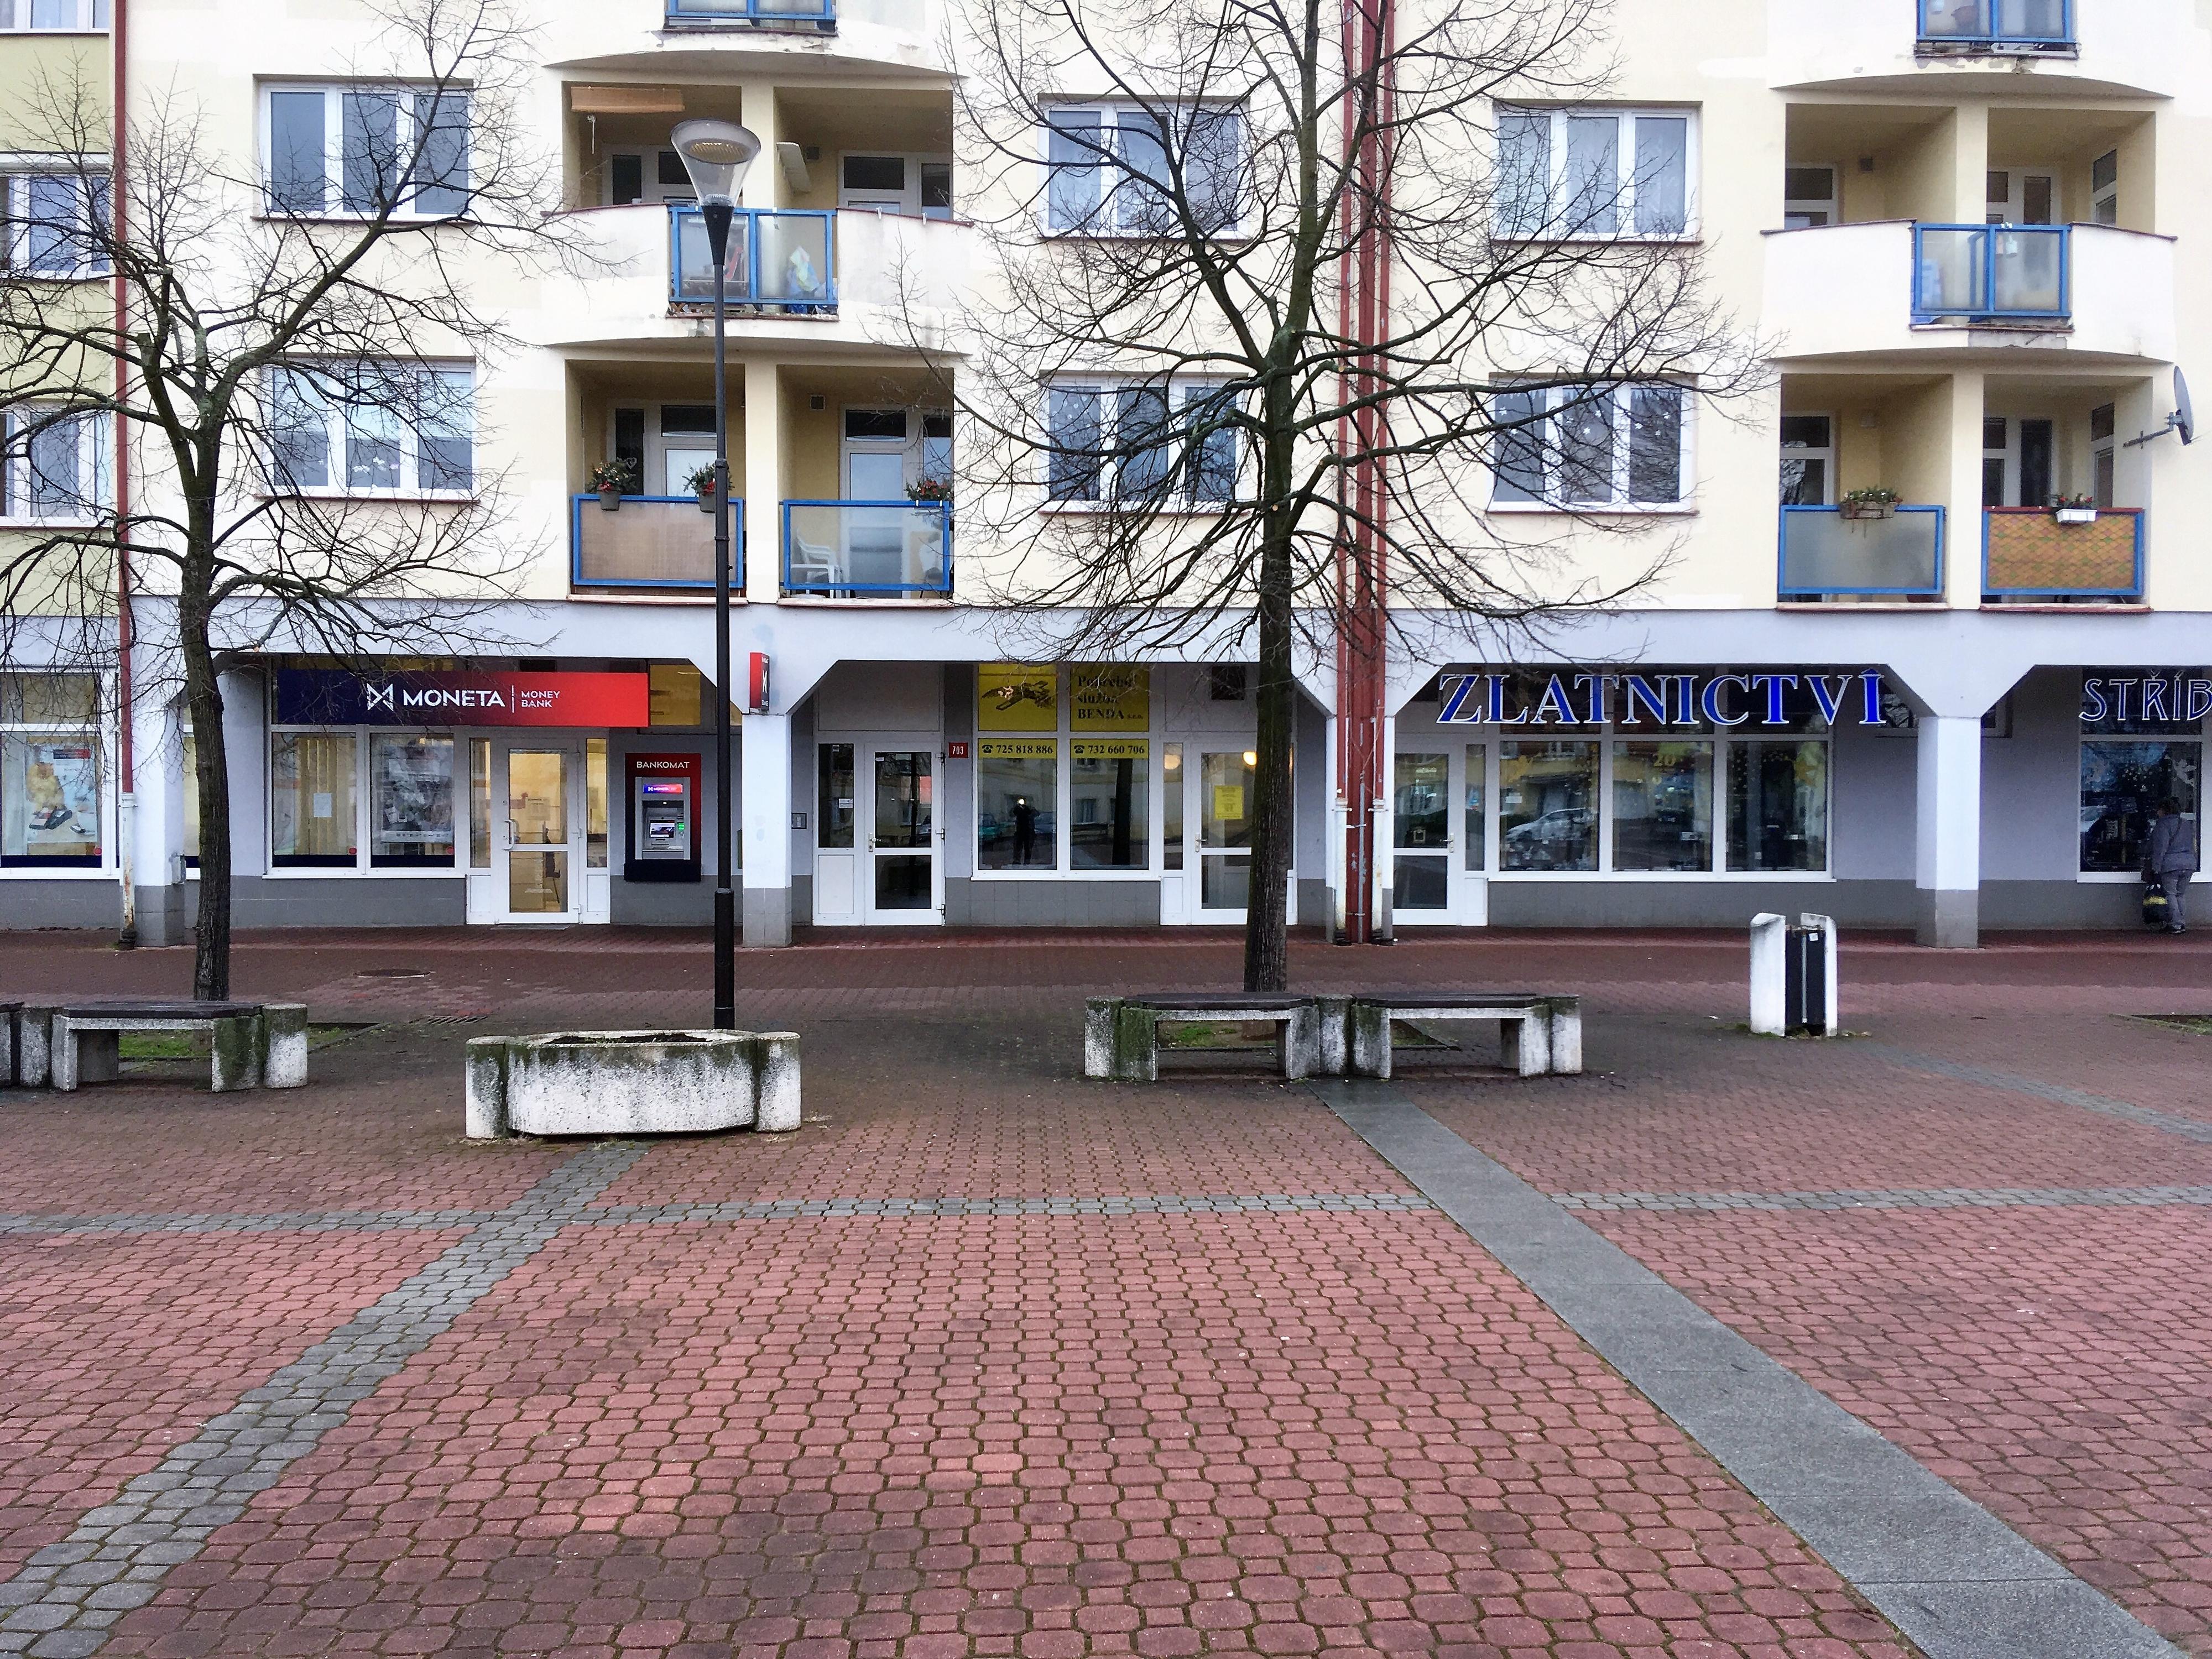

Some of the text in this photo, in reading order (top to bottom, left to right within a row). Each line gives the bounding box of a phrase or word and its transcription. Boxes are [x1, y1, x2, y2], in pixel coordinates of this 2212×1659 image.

[403, 689, 505, 707] MONETA
[1078, 708, 1124, 719] BENDA
[952, 746, 964, 755] 703
[997, 745, 1053, 754] 725 818 886
[1088, 745, 1144, 754] 732 660 706
